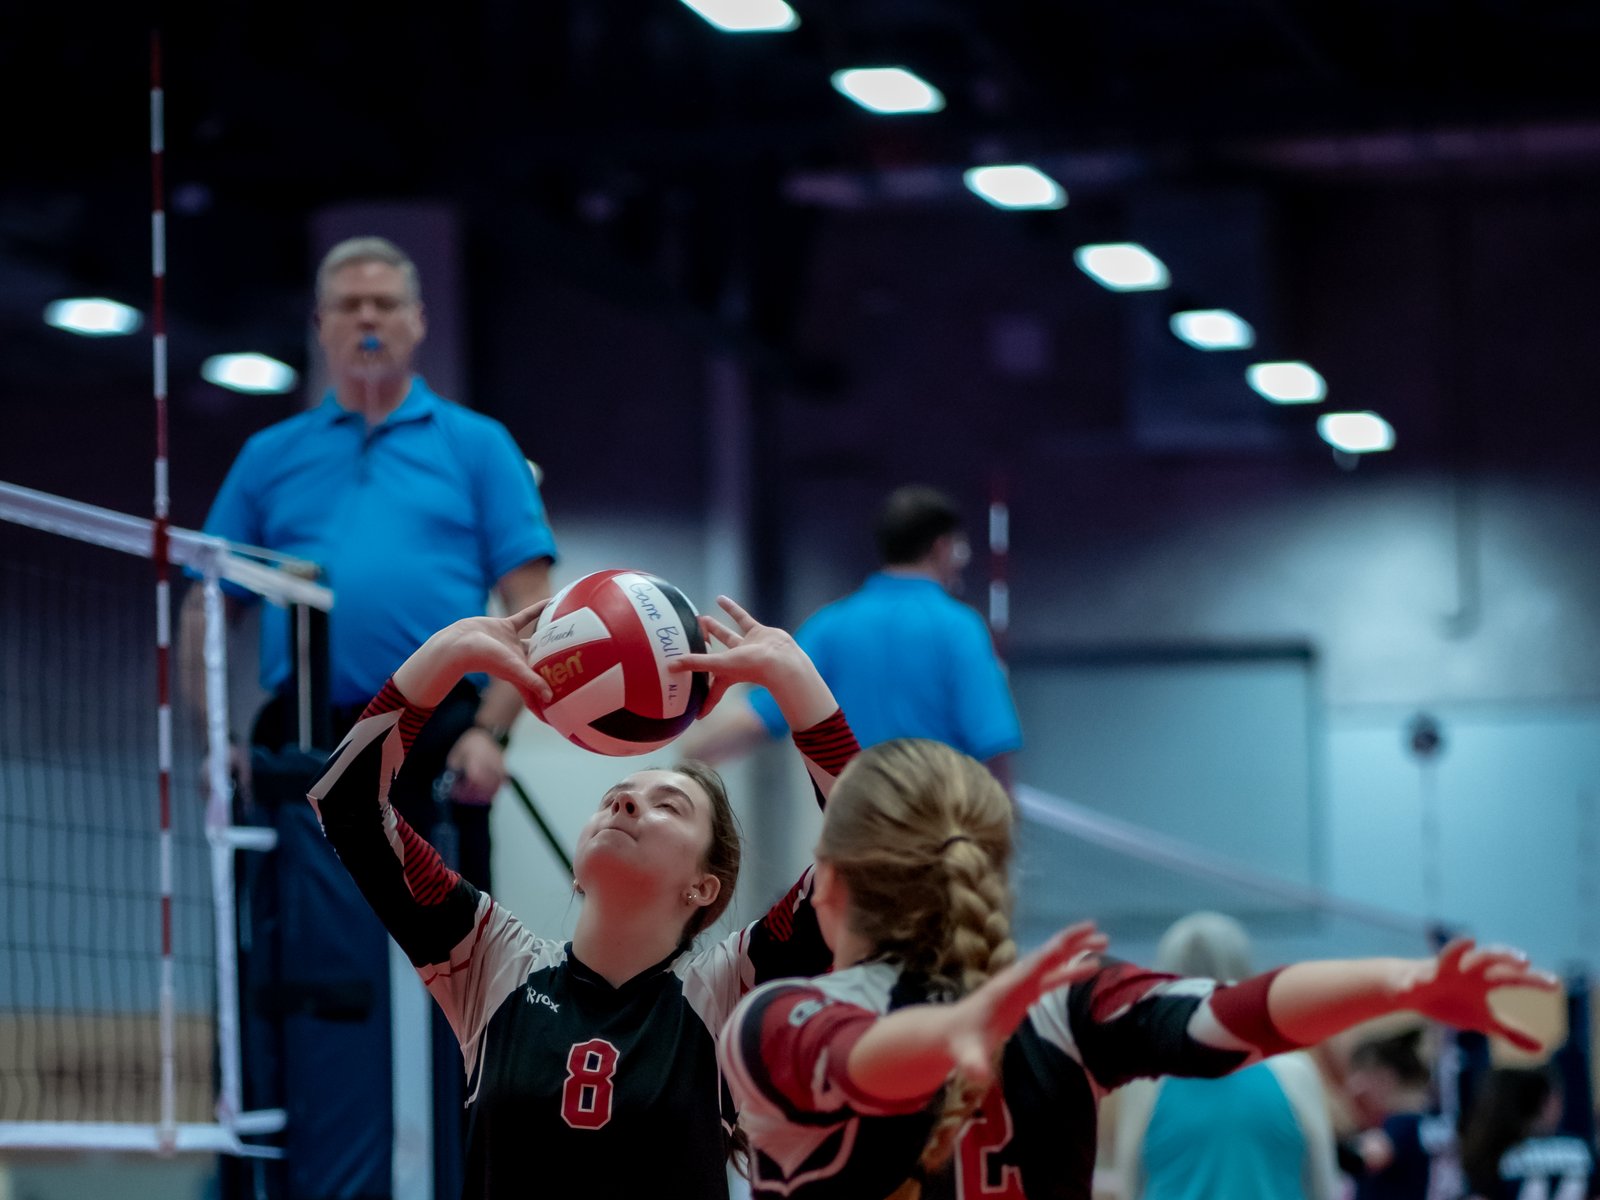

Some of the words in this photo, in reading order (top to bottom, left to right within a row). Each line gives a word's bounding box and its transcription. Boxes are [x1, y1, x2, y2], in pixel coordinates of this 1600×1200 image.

[630, 583, 661, 620] Game
[656, 626, 683, 658] Ball
[560, 1038, 620, 1130] 8
